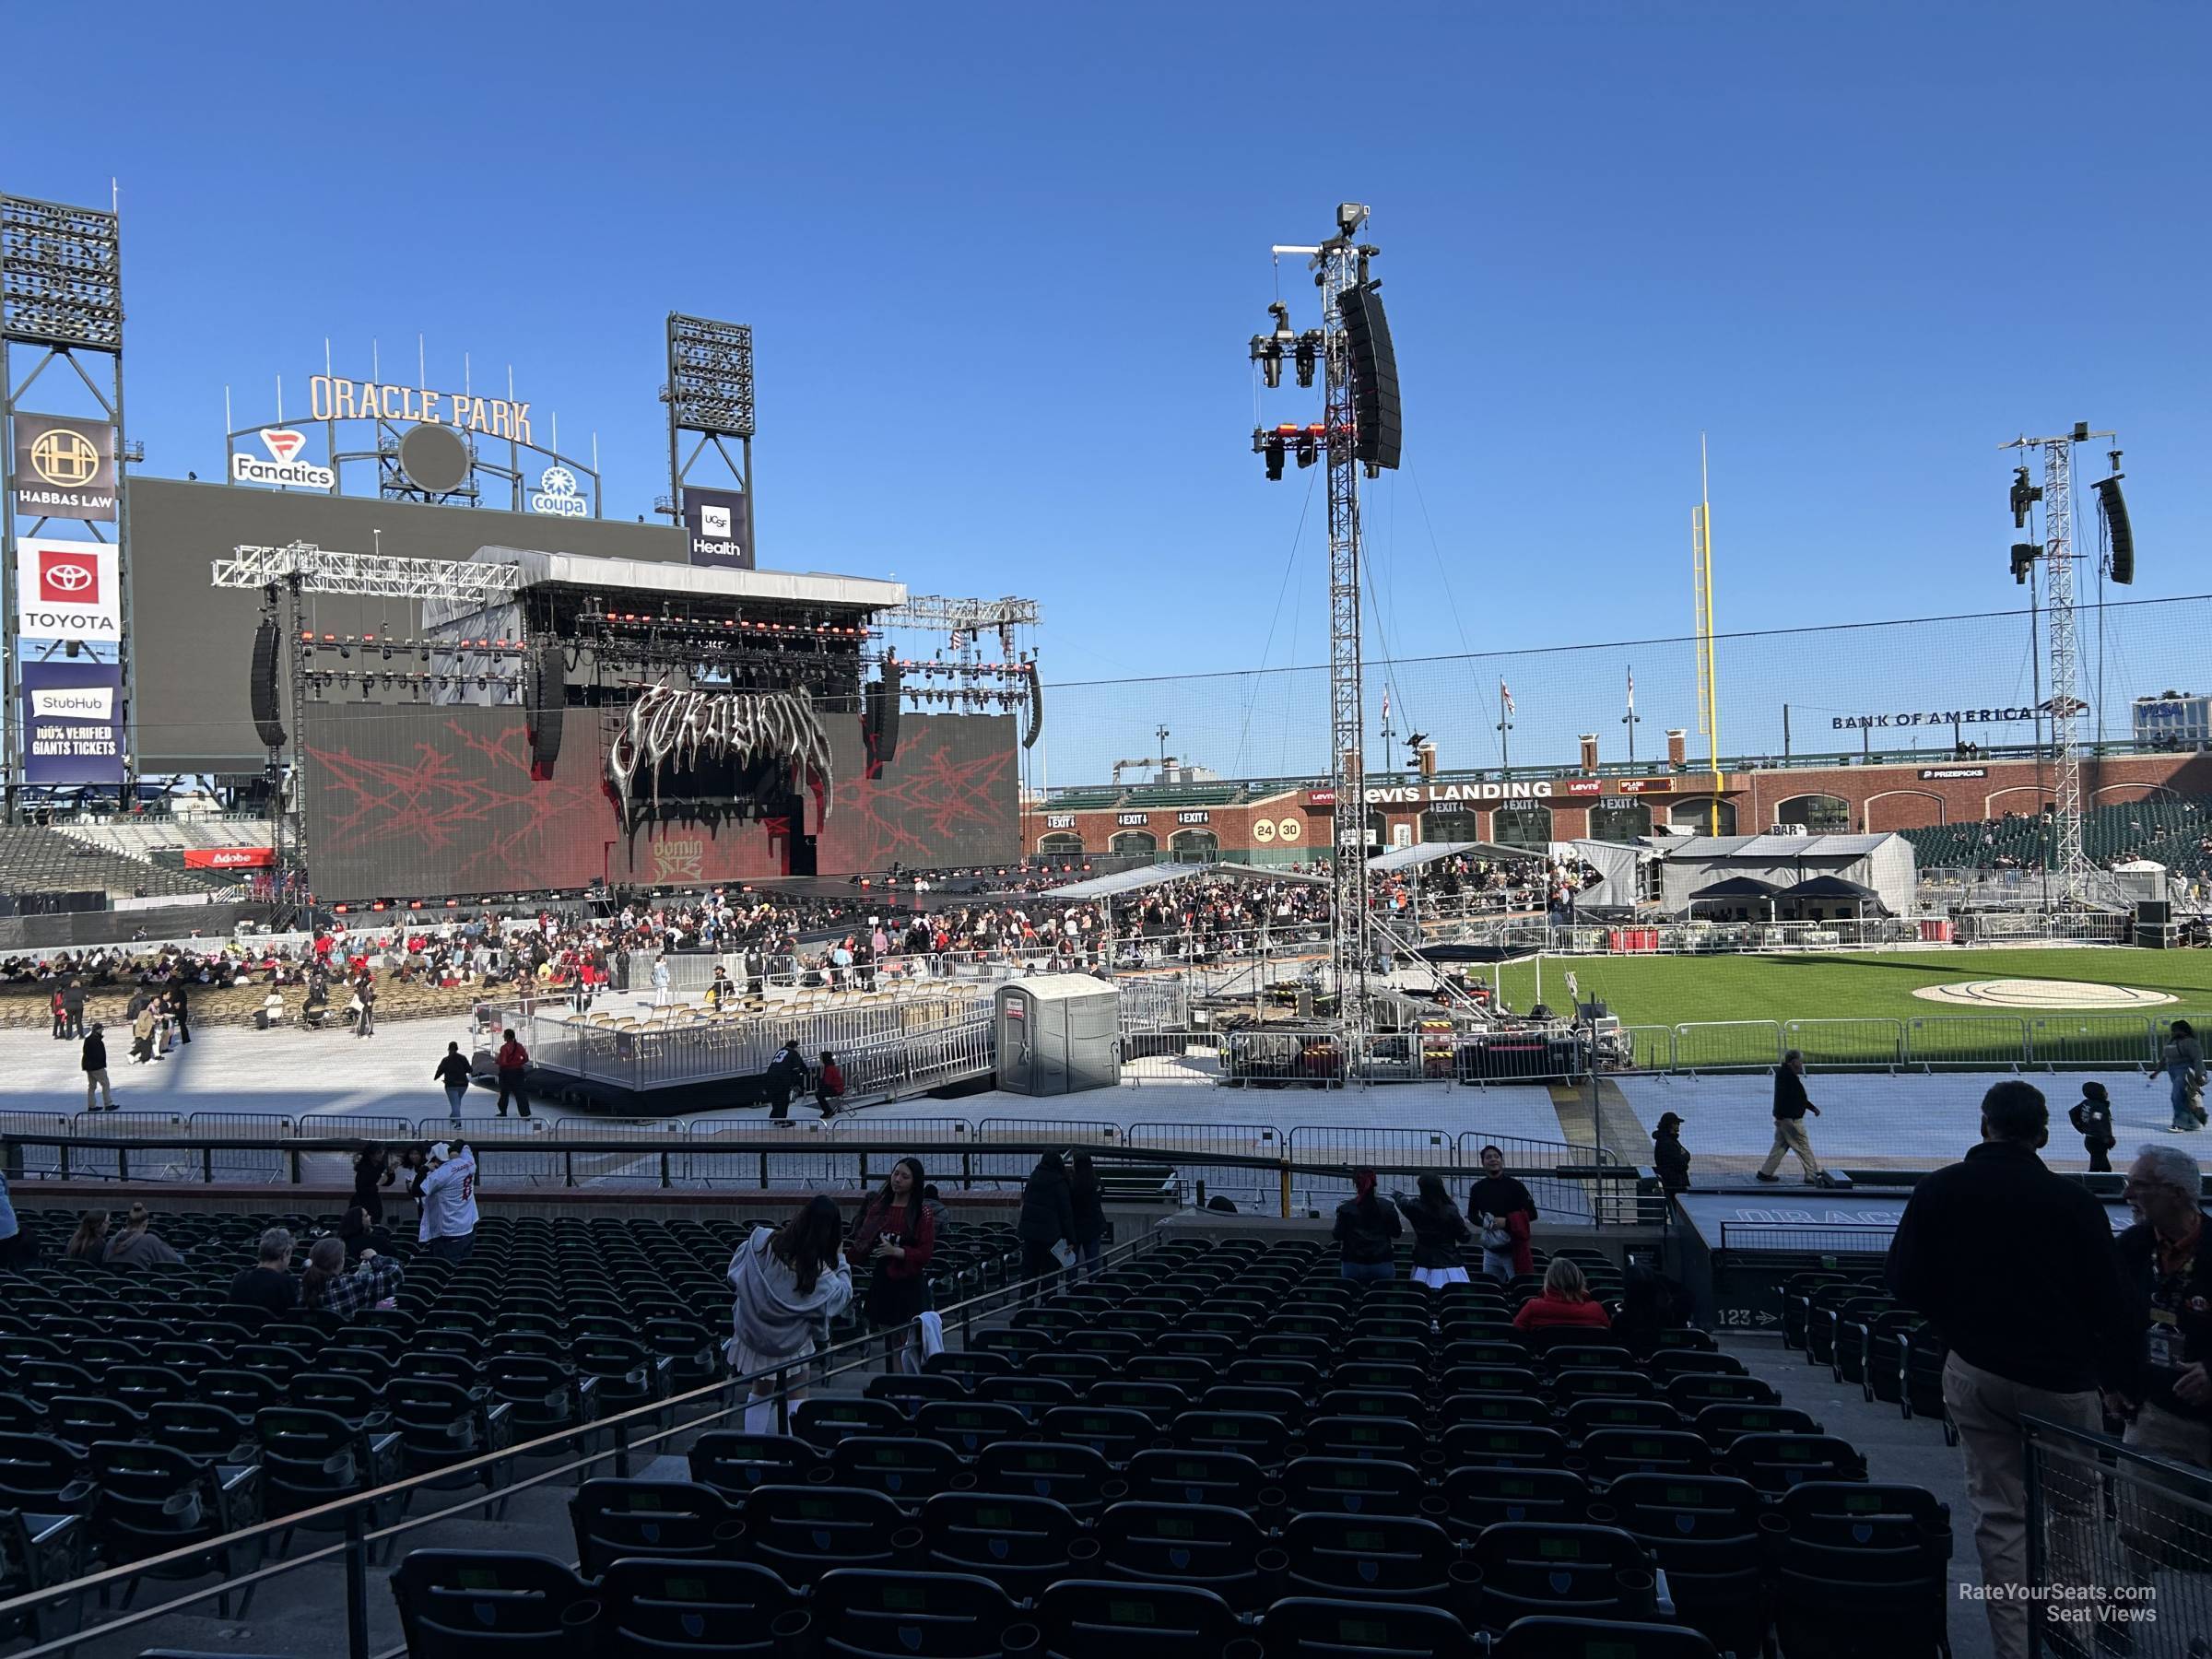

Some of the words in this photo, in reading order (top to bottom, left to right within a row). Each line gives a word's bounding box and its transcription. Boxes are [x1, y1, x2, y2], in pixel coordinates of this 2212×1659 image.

[311, 375, 440, 424] ORACLE
[452, 394, 533, 446] PARK
[238, 458, 330, 485] Fanatics
[19, 490, 79, 506] HABBAS
[82, 496, 112, 509] LAW
[535, 496, 583, 515] coupa
[705, 514, 727, 528] UCSF
[693, 538, 741, 557] Health
[26, 613, 114, 630] TOYOTA
[43, 697, 102, 709] StubHub
[1832, 714, 1888, 730] BANK
[1896, 713, 1923, 726] OF
[1929, 707, 2032, 724] AMERICA
[37, 726, 64, 739] 100%
[66, 726, 112, 740] VERIFIED
[32, 741, 70, 755] GIANTS
[73, 741, 116, 755] TICKETS
[1934, 770, 1984, 778] PRIZEPICKS
[1429, 782, 1552, 801] LANDING
[1436, 802, 1458, 812] EXIT
[1510, 800, 1534, 810] EXIT
[1607, 798, 1631, 809] EXIT
[1052, 818, 1070, 828] EXIT
[1124, 815, 1142, 824] EXIT
[1183, 813, 1203, 823] EXIT
[1257, 826, 1272, 836] 24
[1283, 825, 1297, 835] 30
[1772, 825, 1797, 836] BAR
[213, 853, 251, 864] Adobe
[1718, 1309, 1751, 1325] 123
